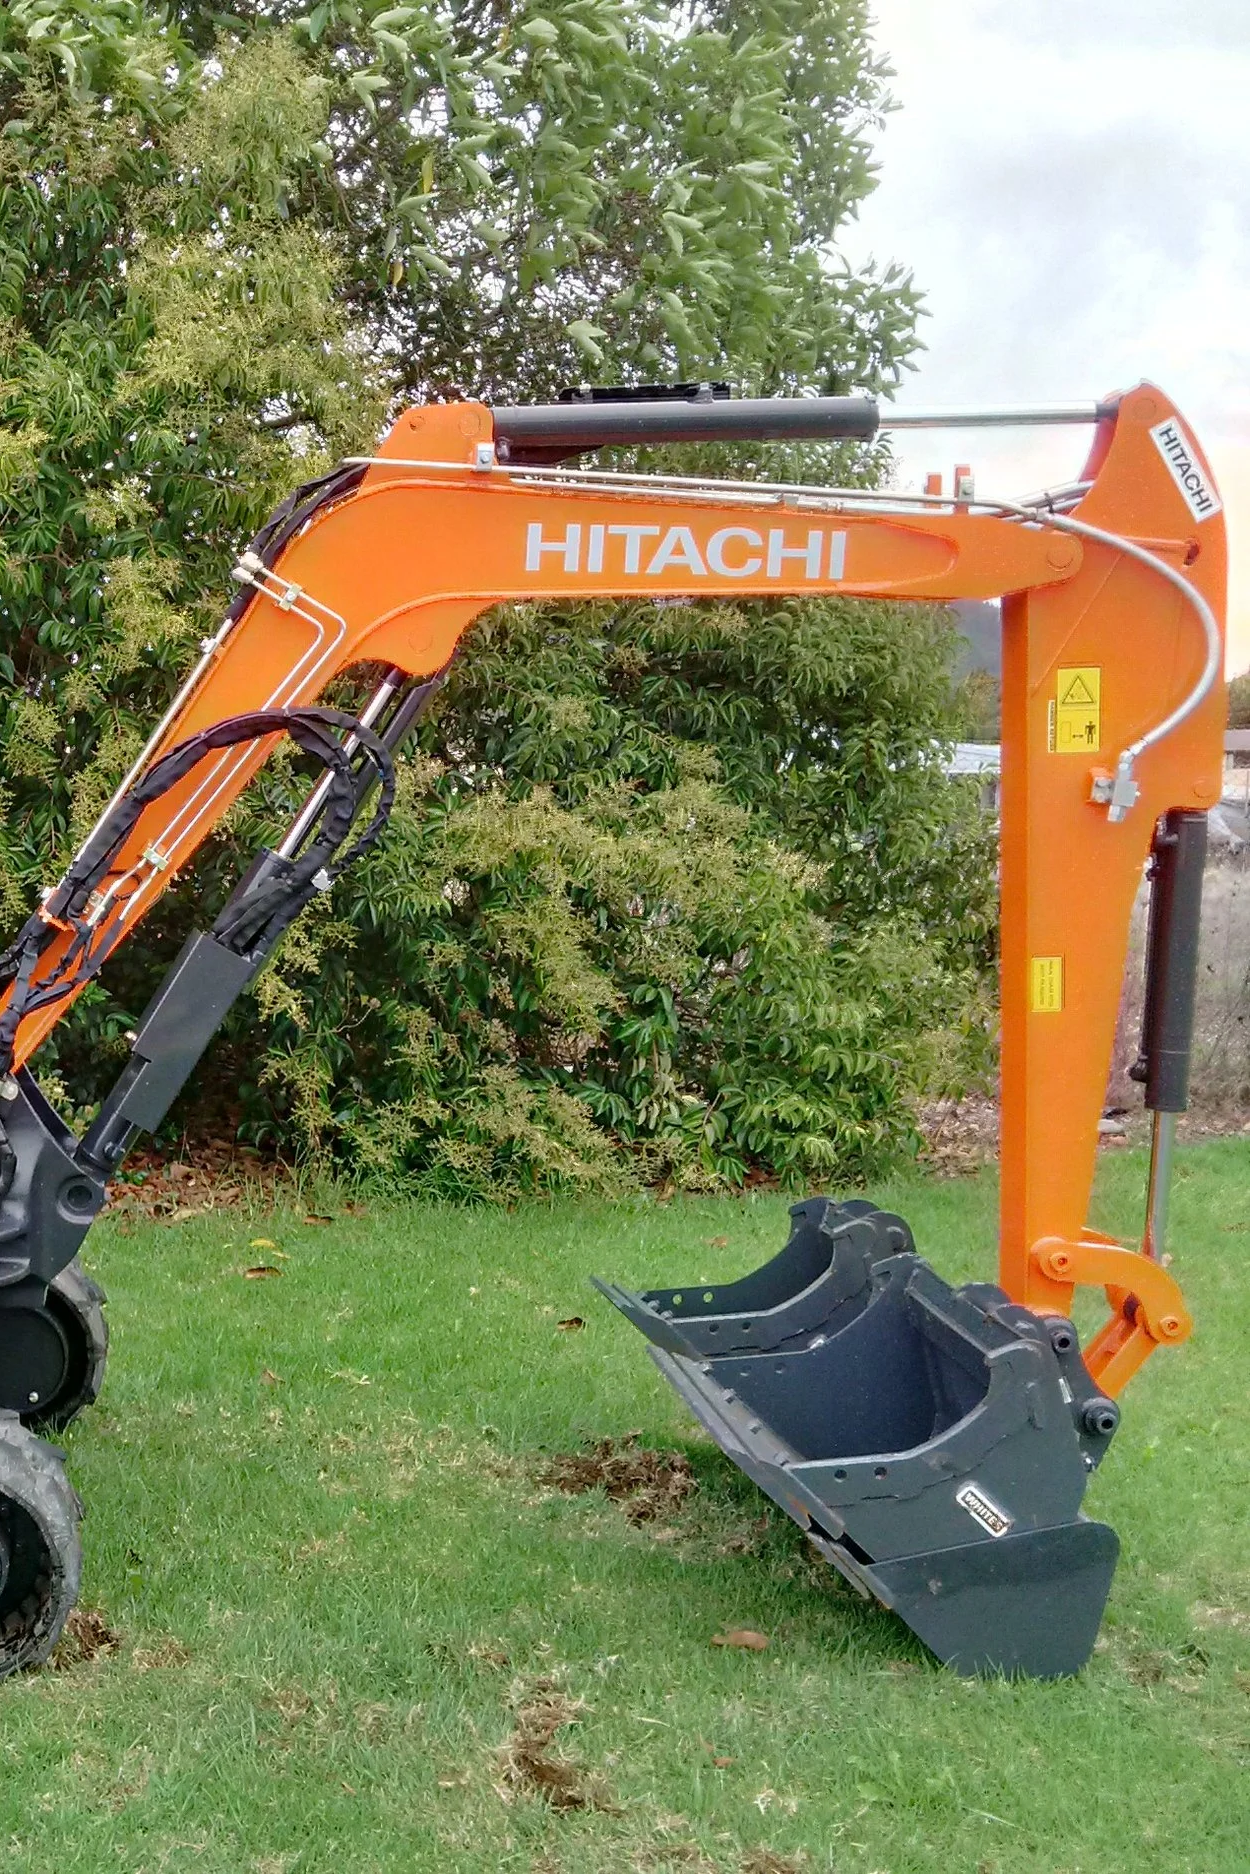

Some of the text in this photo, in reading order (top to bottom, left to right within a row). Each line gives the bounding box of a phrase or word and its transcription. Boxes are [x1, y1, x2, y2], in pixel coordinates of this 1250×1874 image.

[1158, 422, 1214, 513] HITACHI
[524, 522, 847, 580] HITACHI
[964, 1491, 1004, 1531] WHITES
